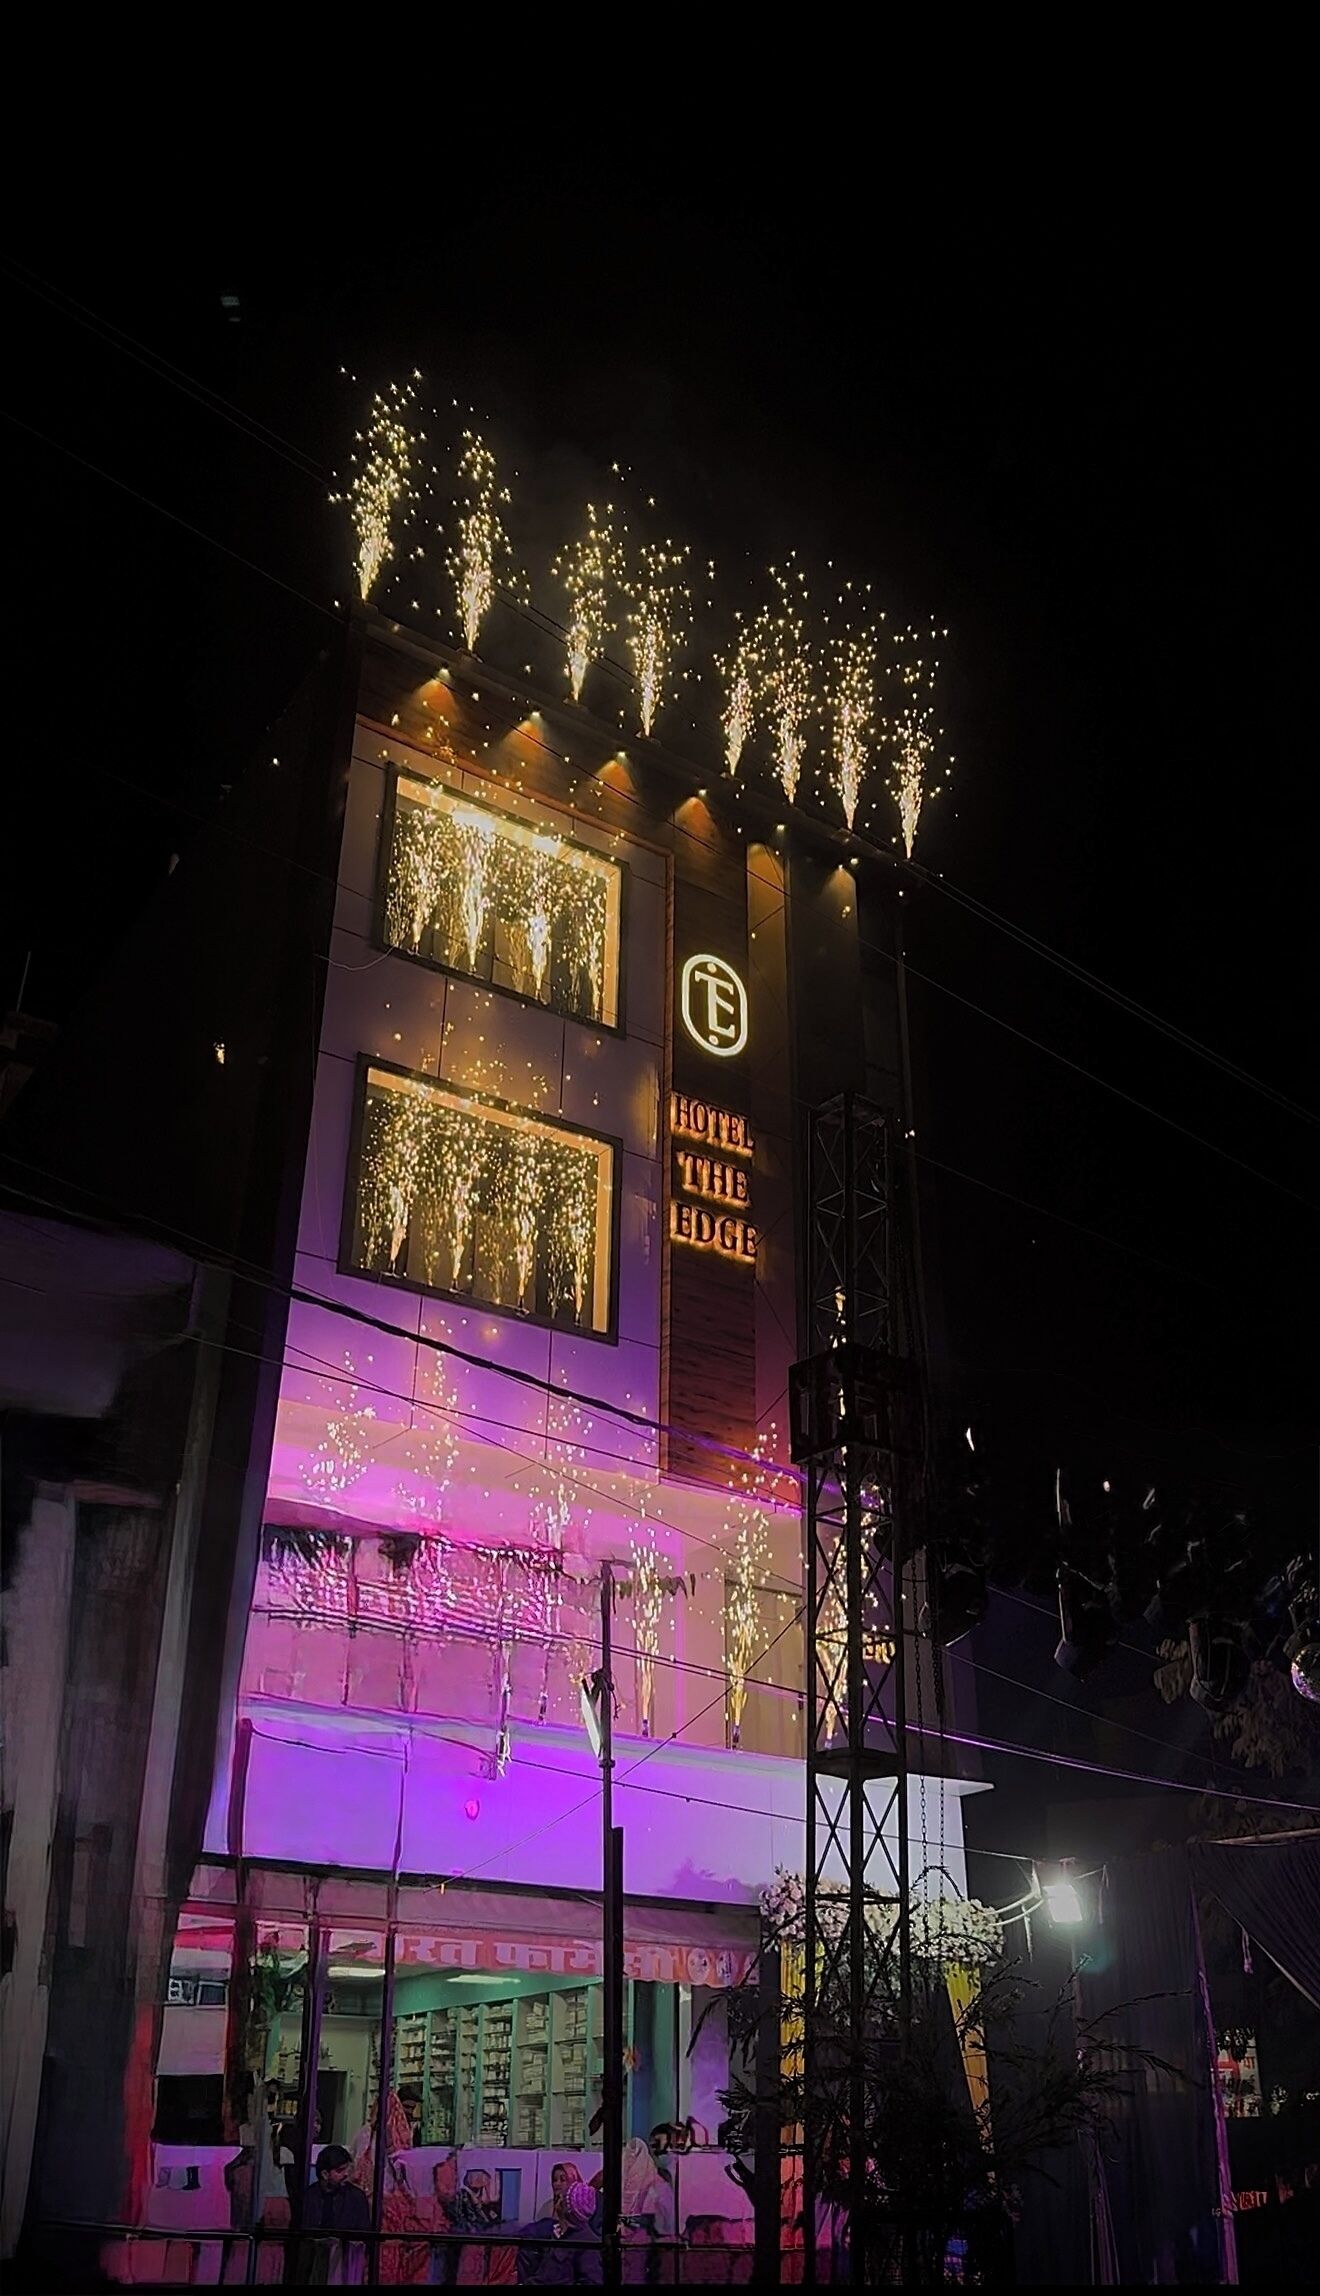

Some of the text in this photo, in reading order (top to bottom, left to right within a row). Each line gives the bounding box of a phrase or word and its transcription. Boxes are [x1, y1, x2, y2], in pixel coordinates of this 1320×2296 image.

[675, 1095, 755, 1151] HOTEL
[683, 1152, 751, 1201] THE
[676, 1202, 758, 1257] EDGE
